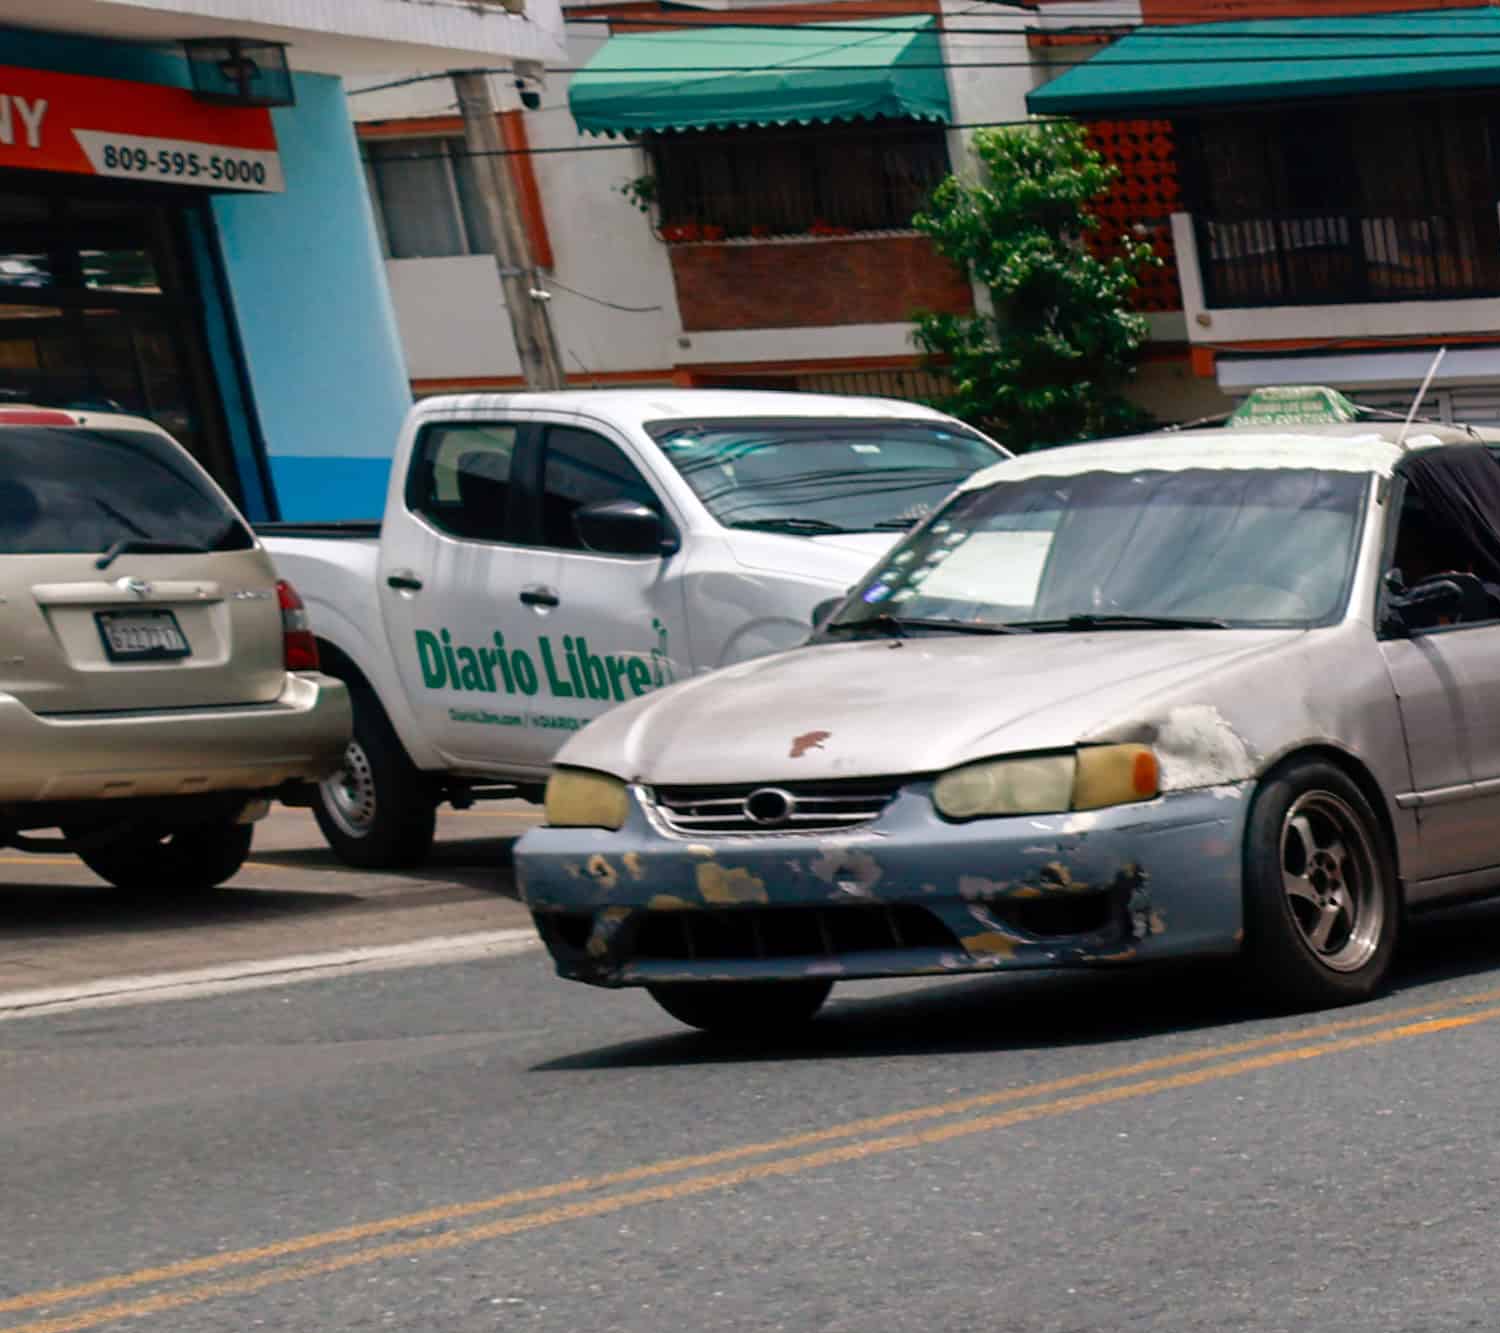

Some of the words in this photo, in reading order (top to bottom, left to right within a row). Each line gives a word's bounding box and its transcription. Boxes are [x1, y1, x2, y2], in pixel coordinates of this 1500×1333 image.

[103, 144, 266, 184] 809-595-5000
[415, 627, 538, 696] Diario
[538, 634, 652, 702] Libre
